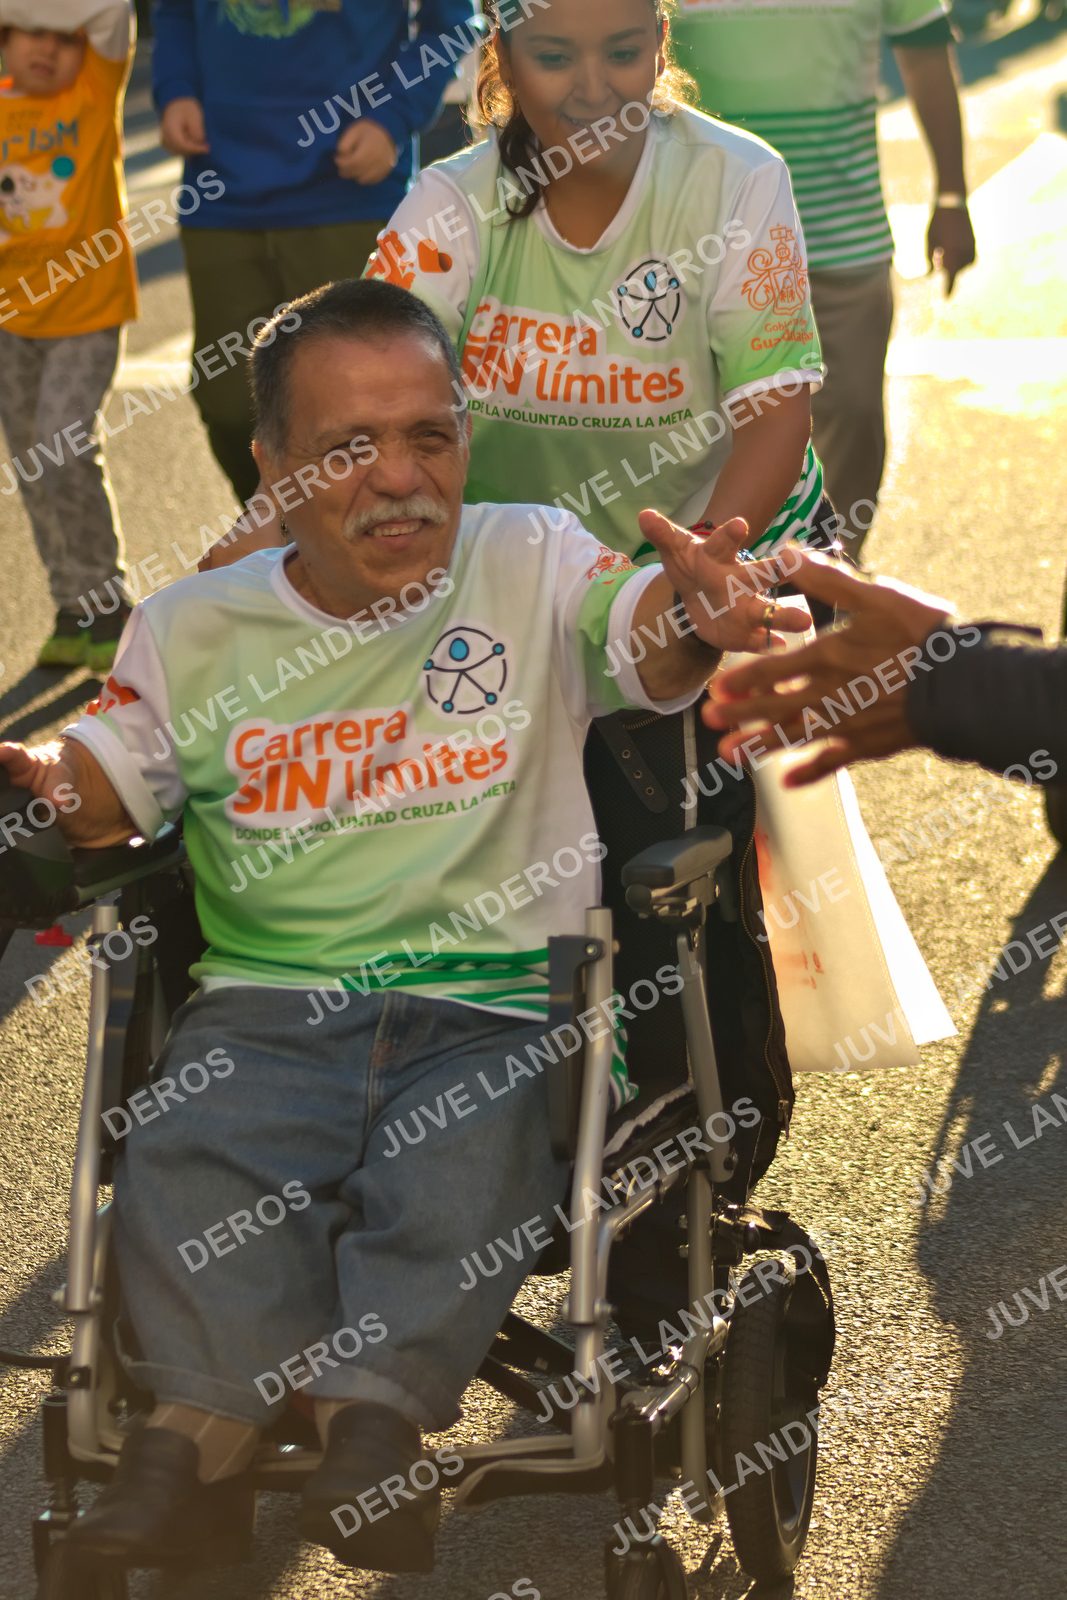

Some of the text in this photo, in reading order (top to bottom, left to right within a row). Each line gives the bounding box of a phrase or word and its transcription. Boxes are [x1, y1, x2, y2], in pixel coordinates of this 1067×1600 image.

[467, 303, 597, 356] Carrera
[536, 357, 684, 405] límites
[503, 408, 579, 427] VOLUNTAD
[582, 416, 632, 428] CRUZA
[636, 415, 655, 428] LA
[658, 408, 693, 426] META
[234, 710, 408, 770] Carrera
[232, 739, 508, 814] SIN límites
[236, 827, 280, 841] DONDE
[400, 800, 457, 821] CRUZA
[460, 796, 479, 812] LA
[480, 780, 516, 802] META
